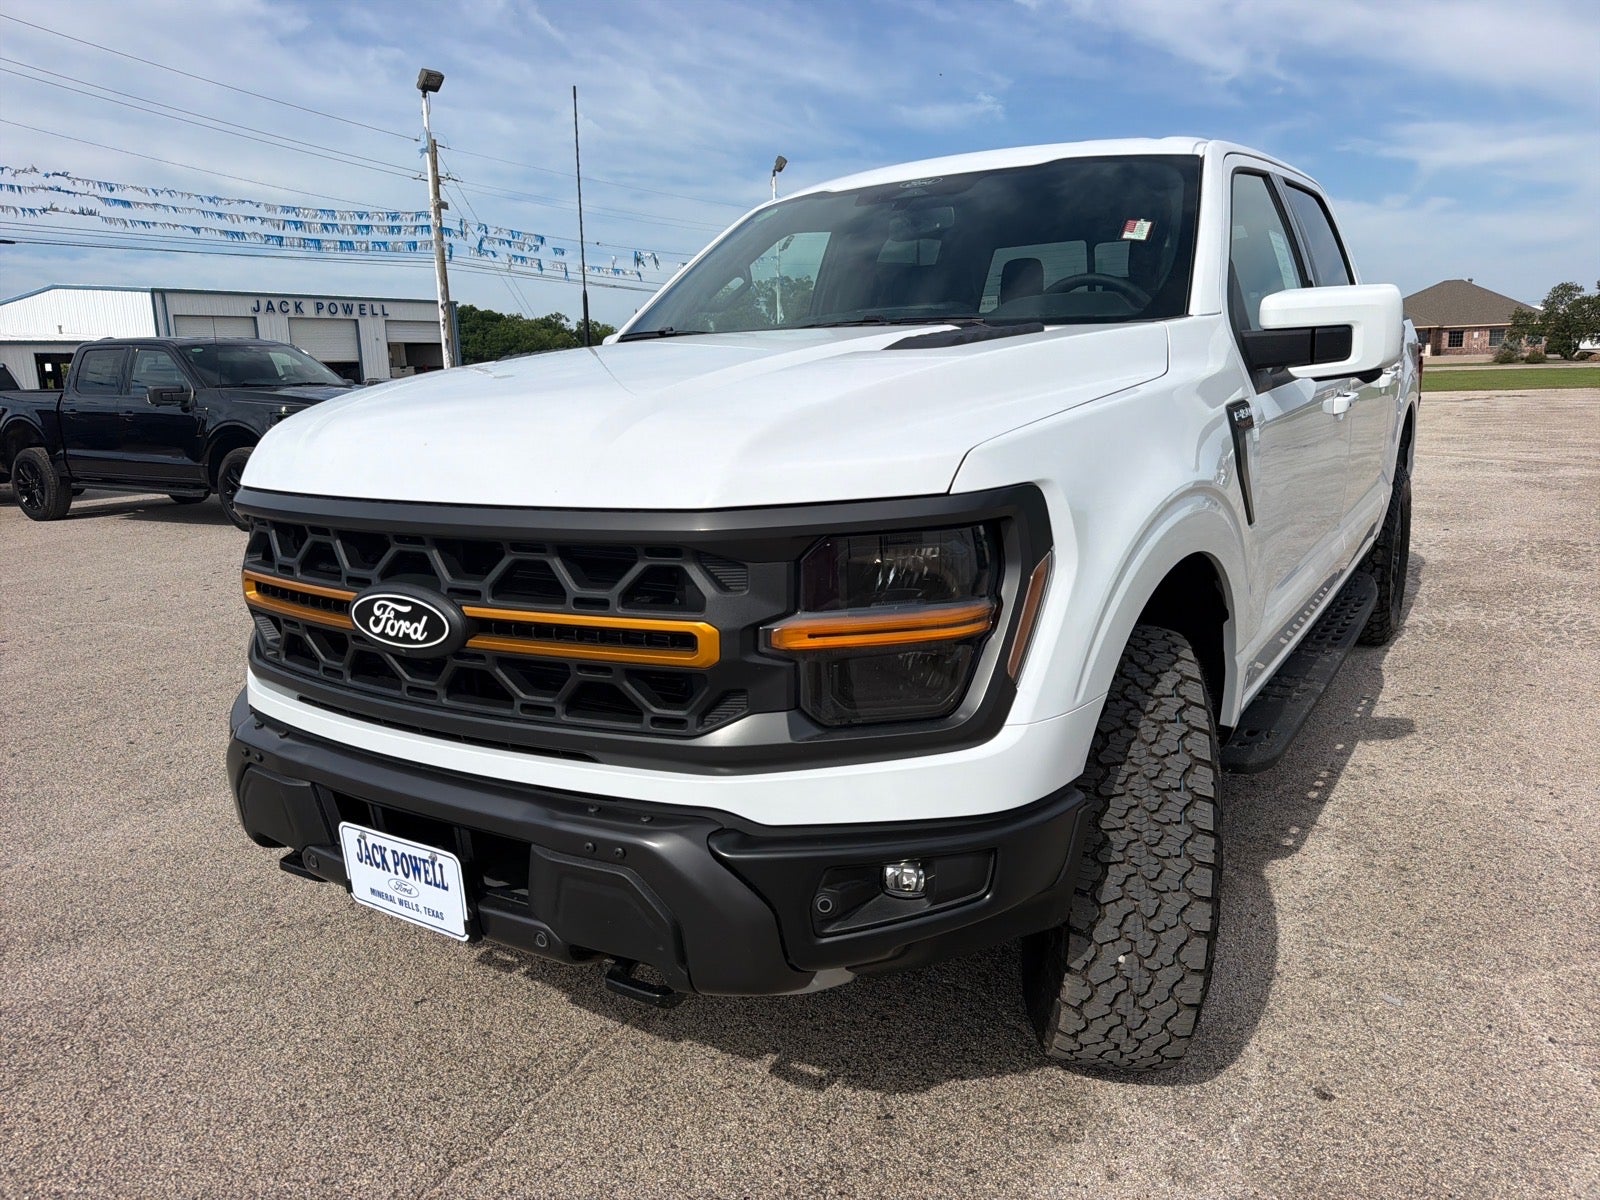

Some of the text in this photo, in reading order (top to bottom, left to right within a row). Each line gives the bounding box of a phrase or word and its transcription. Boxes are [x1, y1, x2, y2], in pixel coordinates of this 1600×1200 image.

[253, 300, 389, 316] JACK POWELL
[369, 600, 428, 641] Ford
[356, 838, 449, 892] JACK POWELL
[370, 887, 445, 921] MINERAL WELLS, TEXAS
[393, 881, 414, 895] Ford
